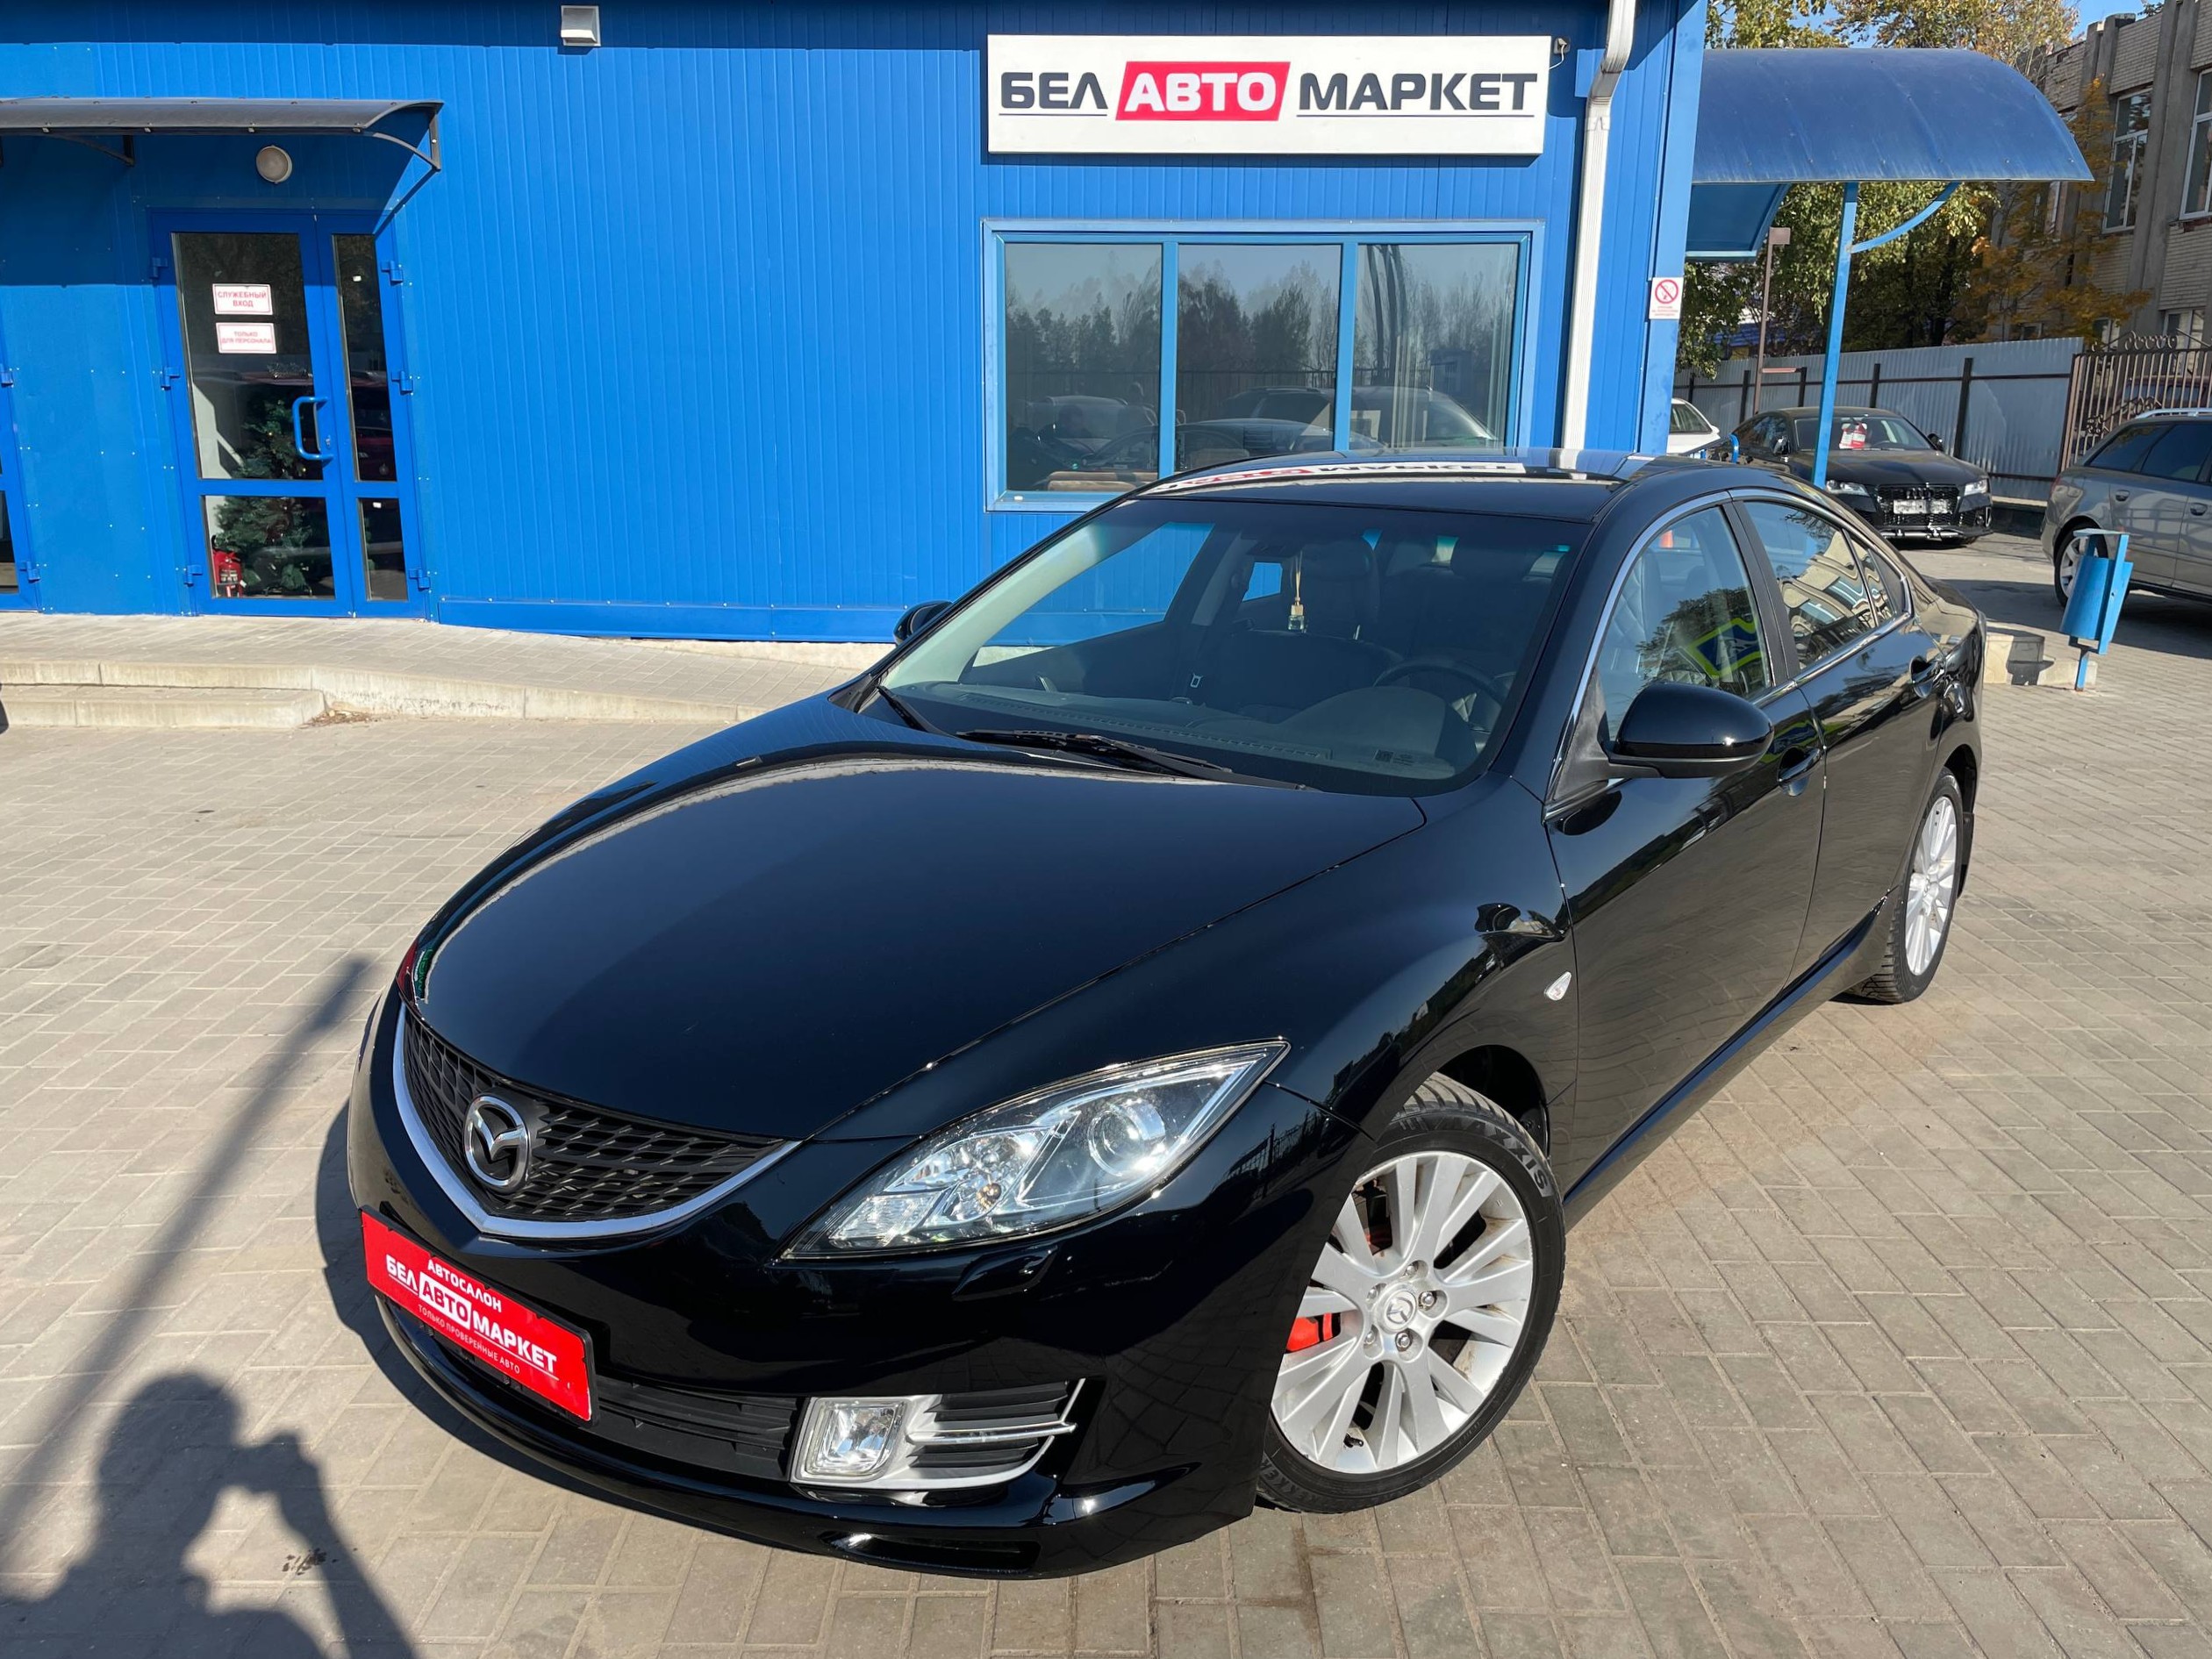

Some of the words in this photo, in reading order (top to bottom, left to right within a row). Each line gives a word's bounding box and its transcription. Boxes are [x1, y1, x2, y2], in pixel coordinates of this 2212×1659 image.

[1000, 71, 1109, 110] БЕЛ
[1124, 71, 1277, 113] АВТО
[1298, 72, 1538, 111] МАРКЕТ
[386, 1255, 419, 1292] БЕЛ
[422, 1280, 469, 1323] АВТО
[472, 1310, 557, 1374] МАРКЕТ
[427, 1259, 502, 1312] АВТОСАЛОН
[418, 1304, 446, 1327] ТОЛЬКО
[446, 1321, 498, 1362] ПРОВЕРЕННЫЕ
[499, 1355, 520, 1375] АВТО
